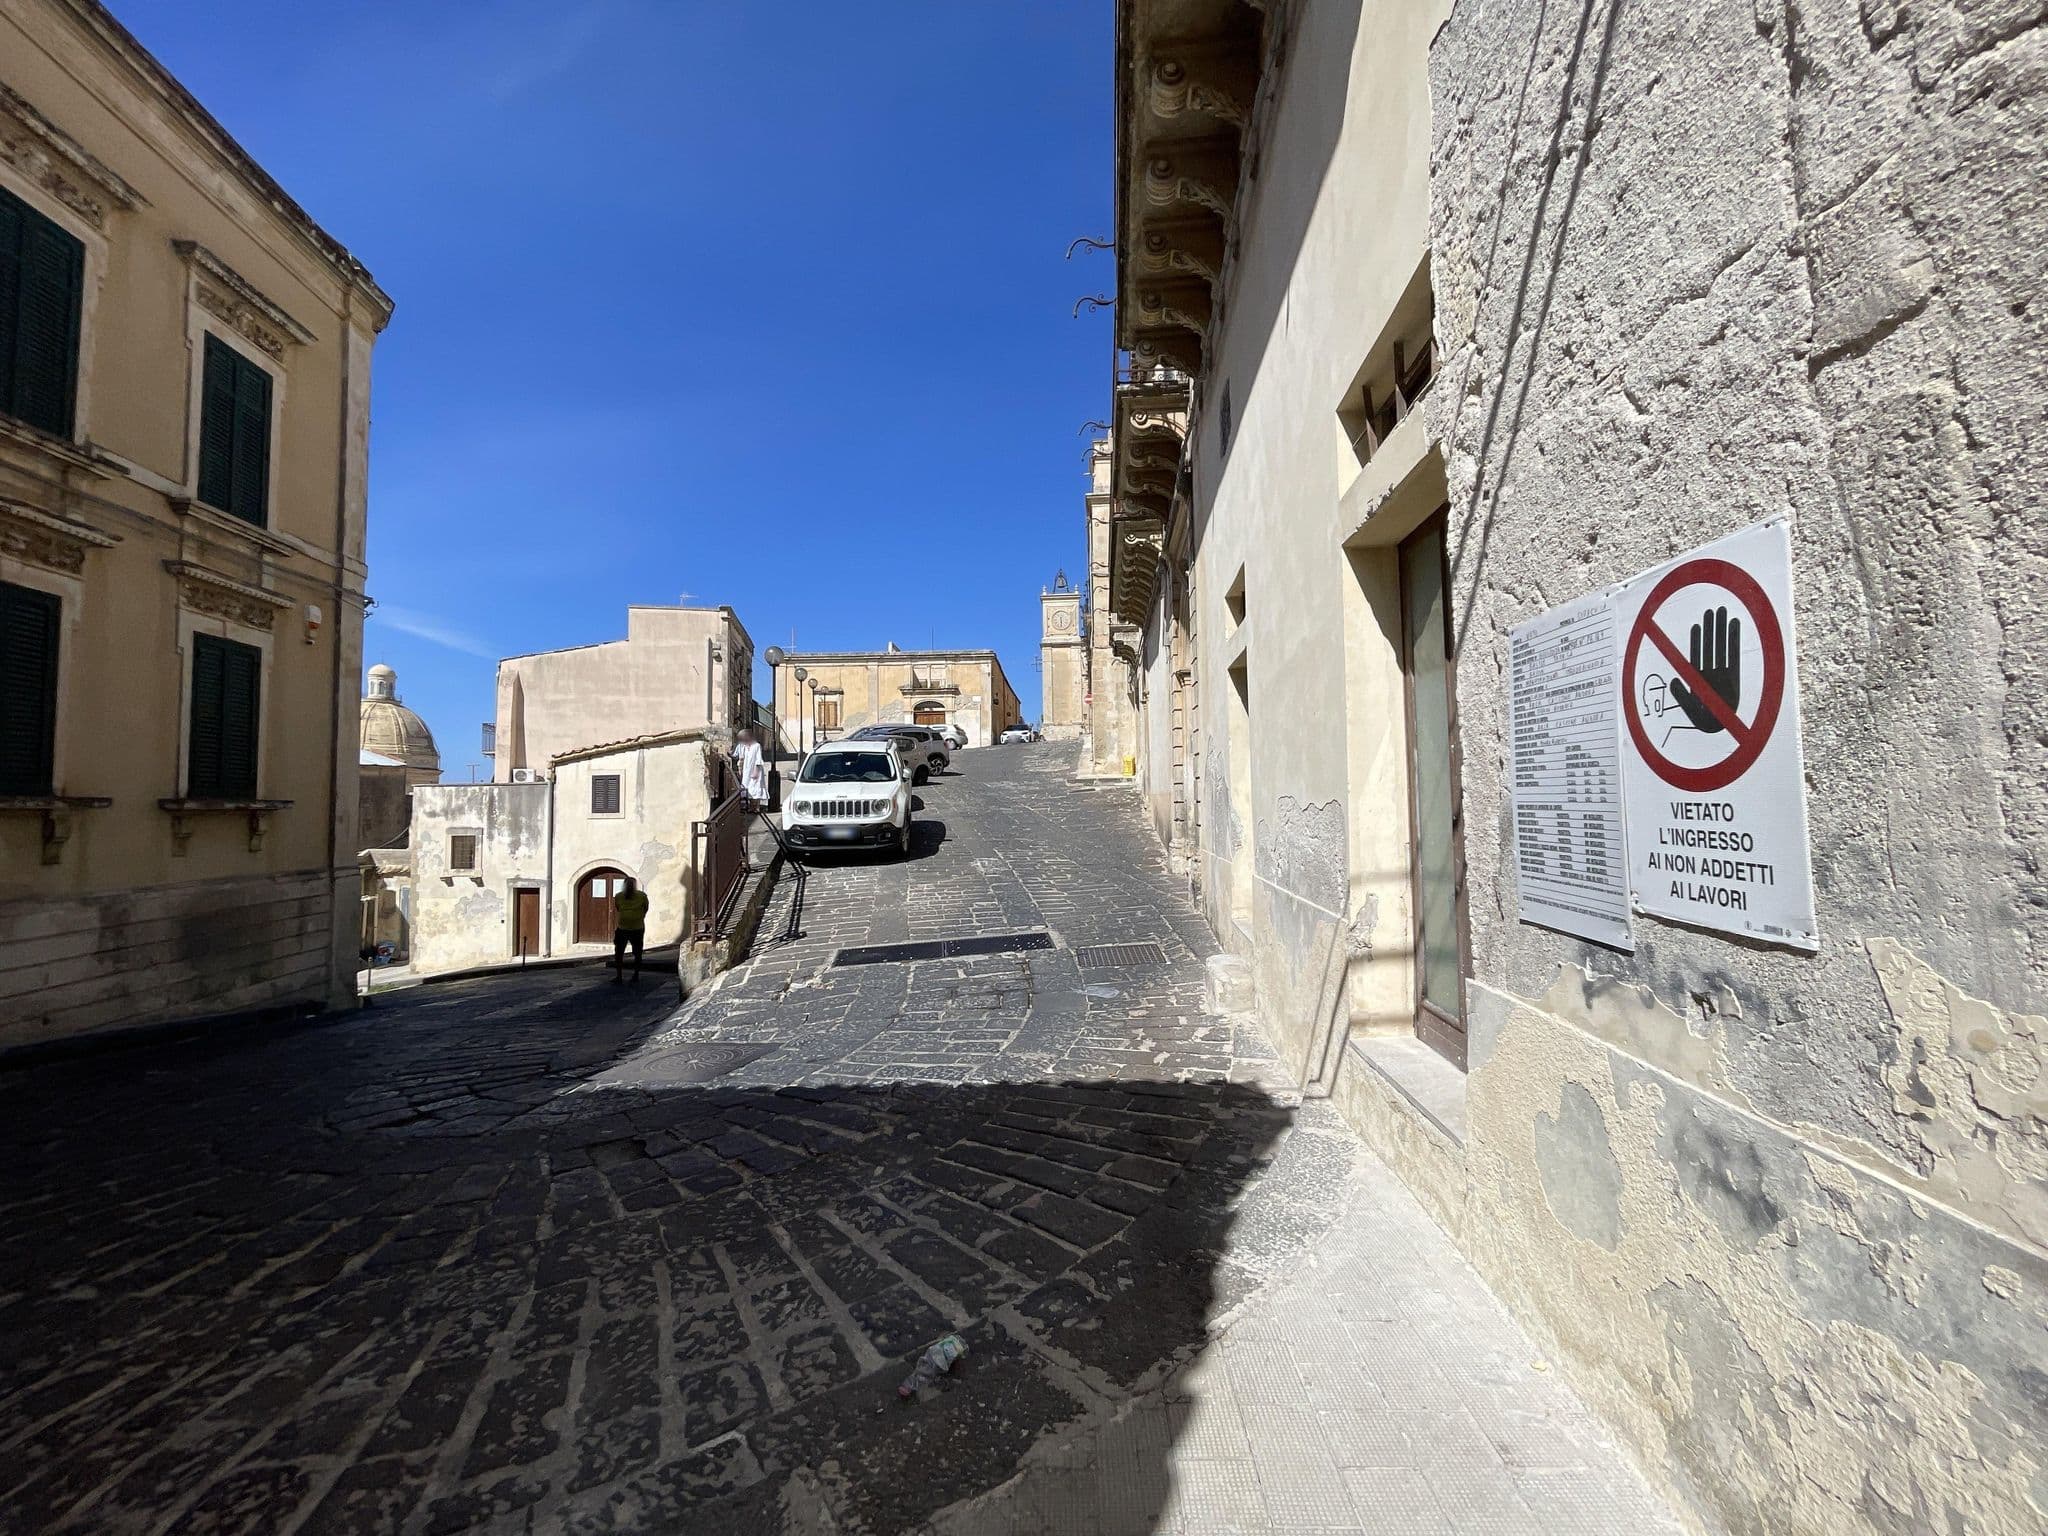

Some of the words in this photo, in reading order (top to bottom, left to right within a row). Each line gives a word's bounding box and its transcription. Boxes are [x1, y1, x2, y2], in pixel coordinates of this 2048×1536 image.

[1671, 802, 1734, 822] VIETATO
[1659, 828, 1754, 852] L'INGRESSO
[1648, 852, 1661, 869] AI
[1665, 854, 1696, 874] NON
[1700, 858, 1774, 885] ADDETTI
[1670, 881, 1684, 898] AI
[1688, 883, 1747, 911] LAVORI
